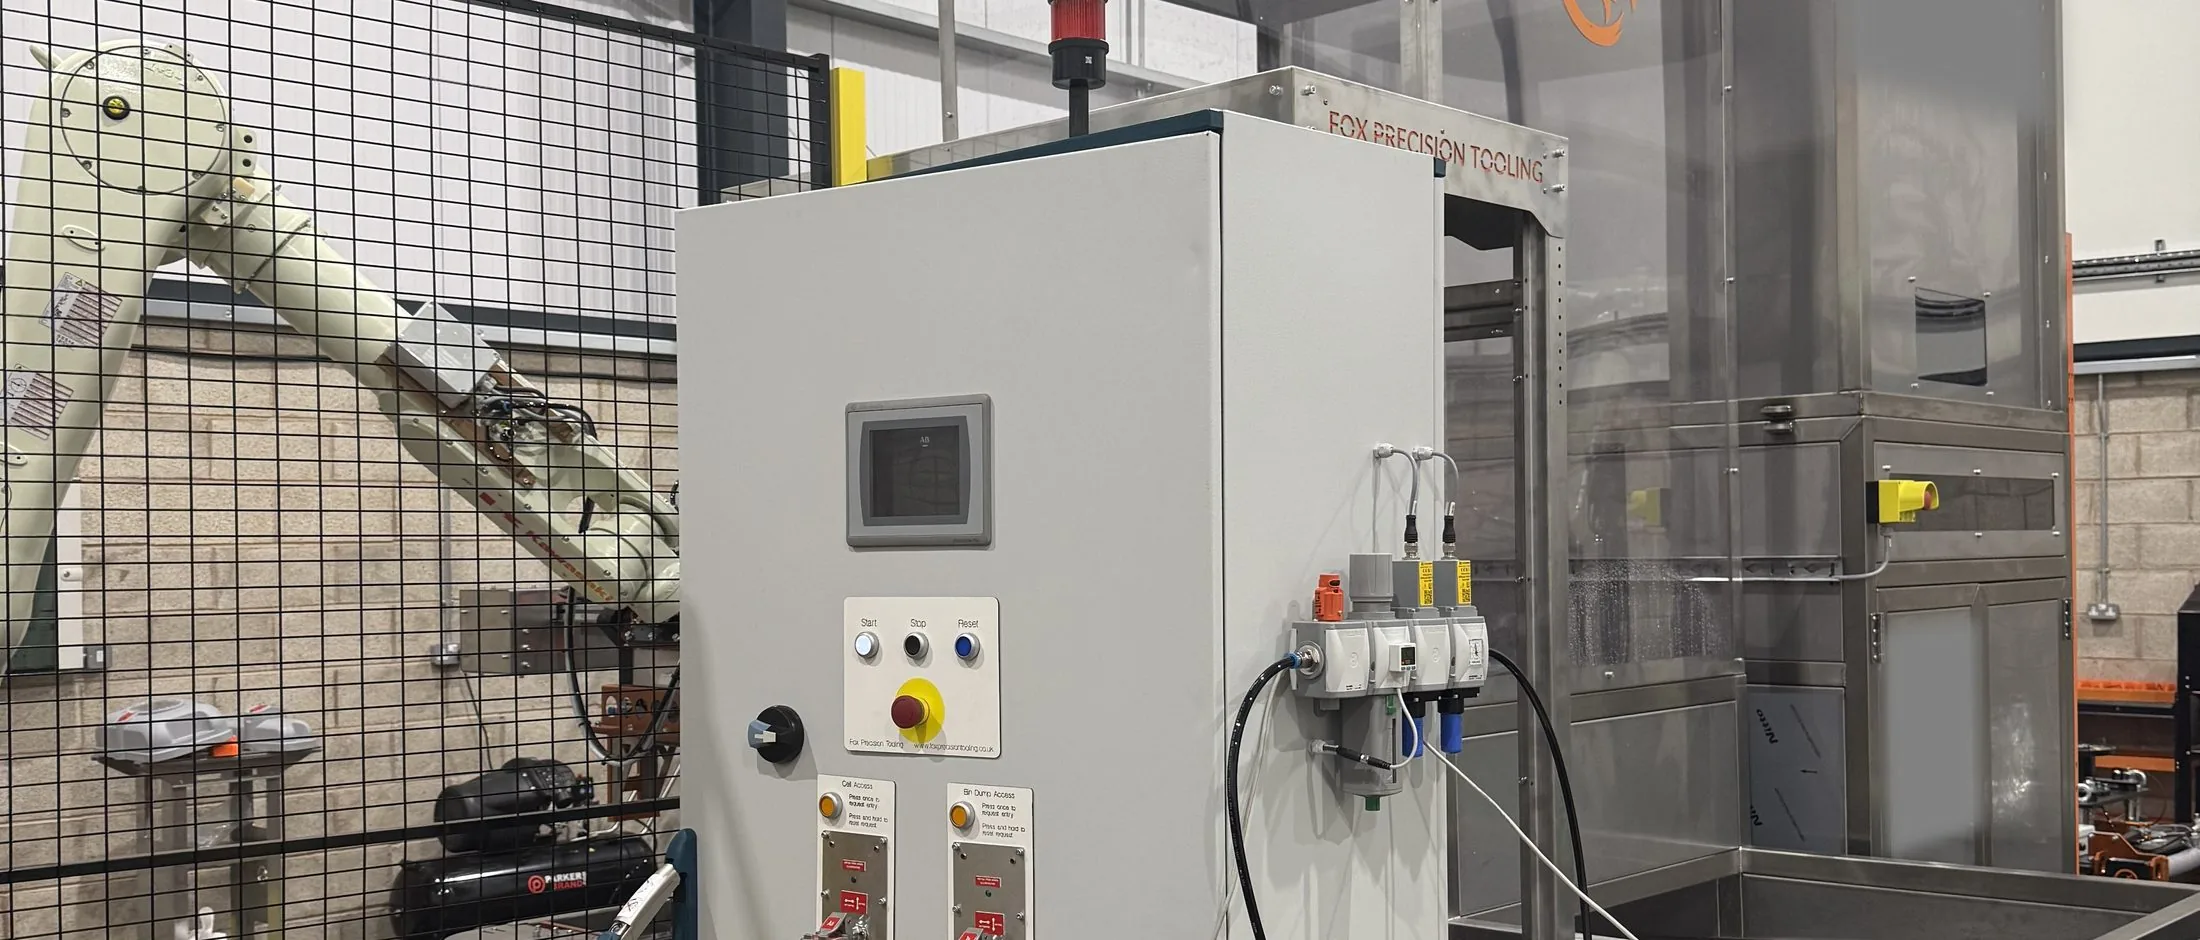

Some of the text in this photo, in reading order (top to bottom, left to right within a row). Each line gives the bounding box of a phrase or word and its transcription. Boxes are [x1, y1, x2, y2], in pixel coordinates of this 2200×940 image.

[1329, 110, 1544, 183] FOX PRECISION TOOLING
[861, 618, 877, 628] Start
[910, 619, 926, 629] Stop
[958, 619, 979, 629] Reset
[1756, 709, 1778, 744] Nitto
[849, 738, 859, 746] Fox
[886, 740, 904, 749] Tooling
[854, 782, 873, 790] Access
[848, 793, 861, 801] Press
[963, 788, 1015, 799] Bin Dump Access
[848, 812, 861, 820] Press
[981, 822, 995, 830] Press
